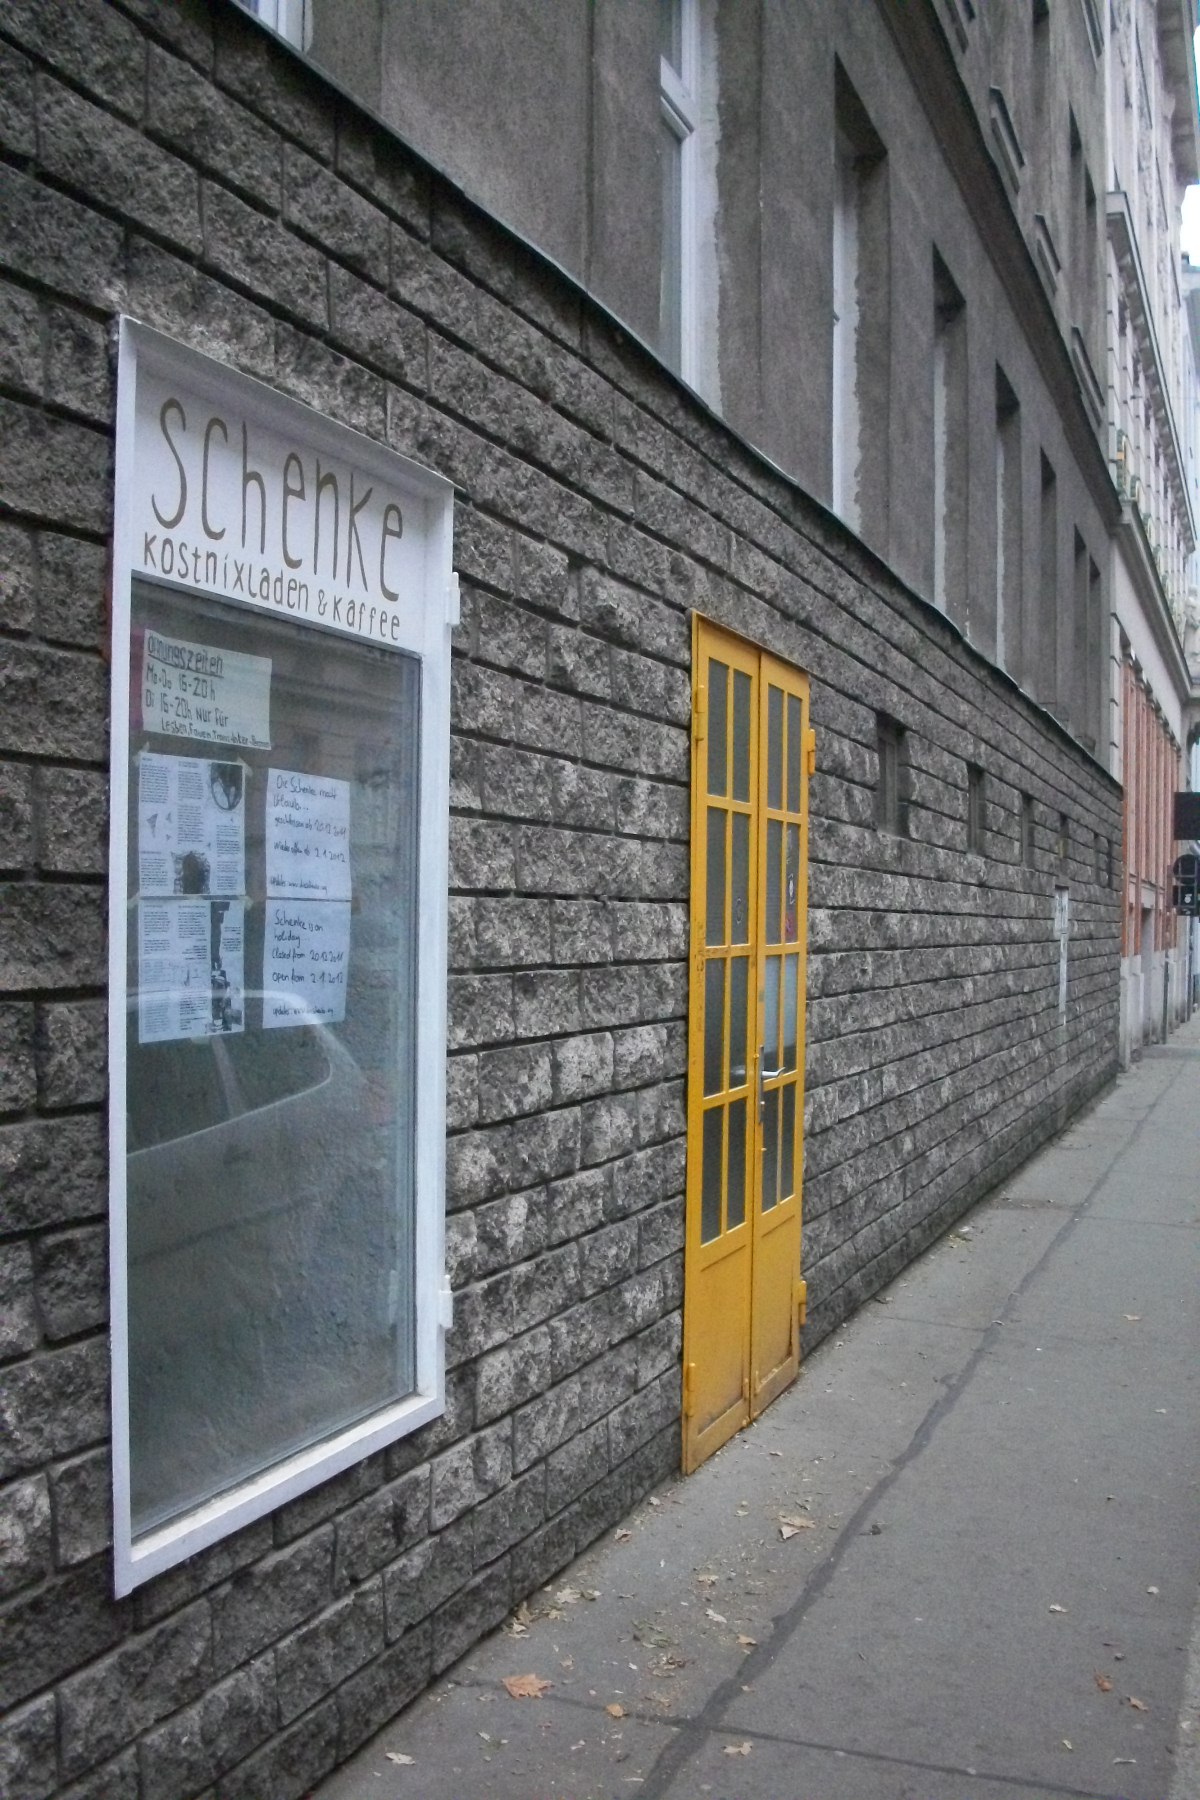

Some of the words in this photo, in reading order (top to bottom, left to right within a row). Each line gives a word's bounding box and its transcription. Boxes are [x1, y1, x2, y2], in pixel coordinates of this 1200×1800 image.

[317, 589, 328, 616] &
[145, 688, 154, 708] Di
[274, 908, 307, 930] Schenke
